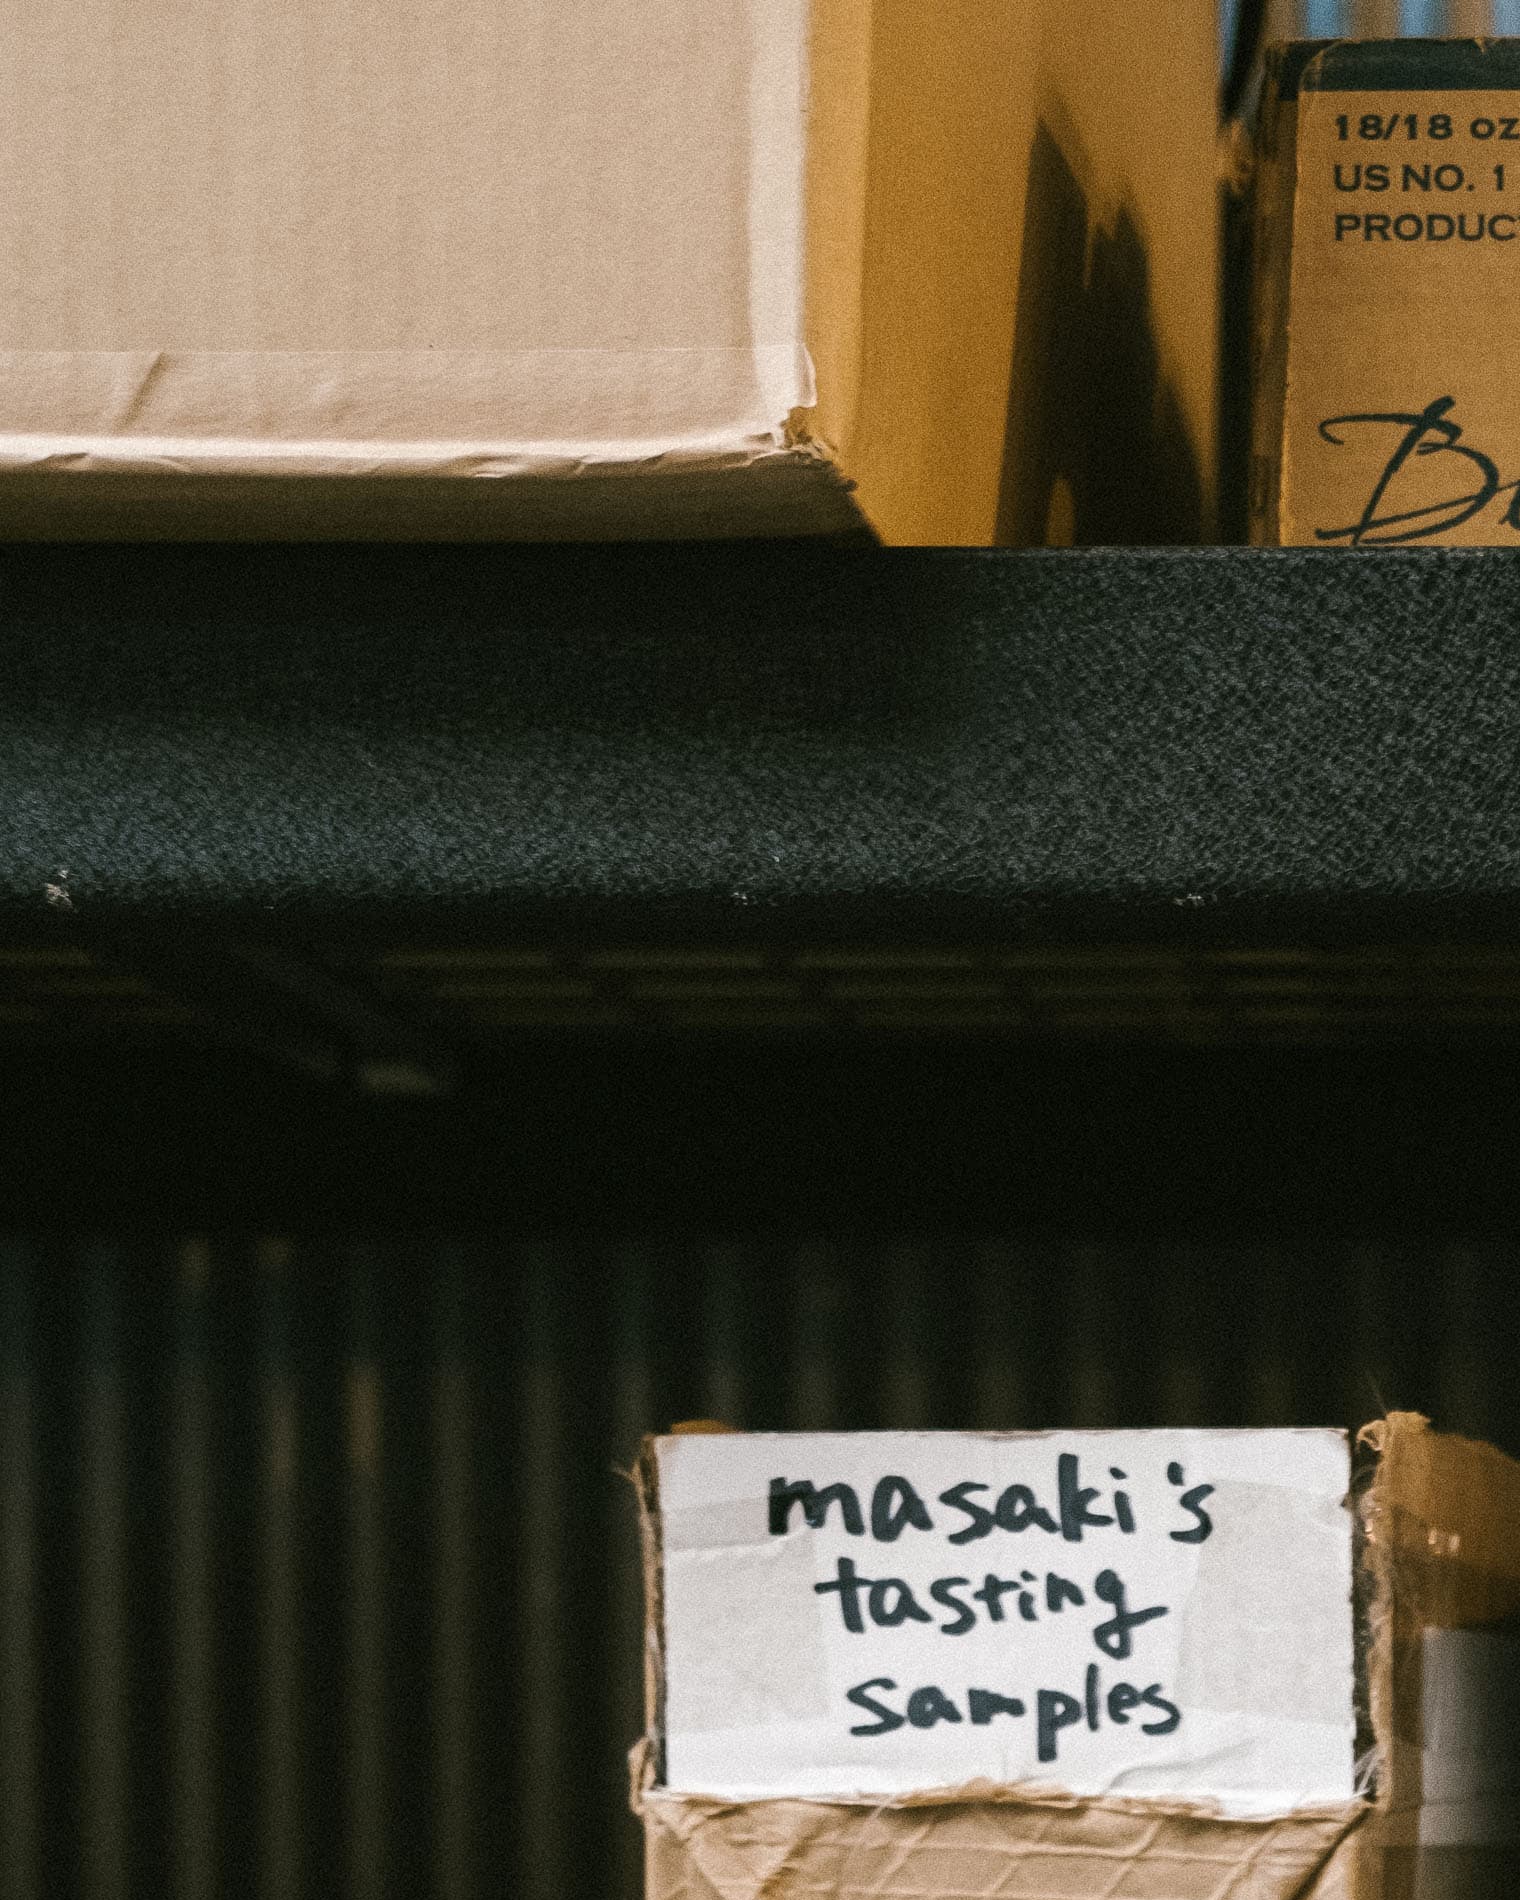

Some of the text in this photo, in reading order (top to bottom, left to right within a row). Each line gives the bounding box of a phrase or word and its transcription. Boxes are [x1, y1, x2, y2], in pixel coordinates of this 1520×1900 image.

[1335, 113, 1453, 141] 18/18
[1470, 116, 1520, 140] oz
[1334, 164, 1504, 191] US NO. 1
[767, 1453, 1216, 1546] masaki's
[814, 1557, 1168, 1659] tasting
[847, 1663, 1182, 1762] samples
